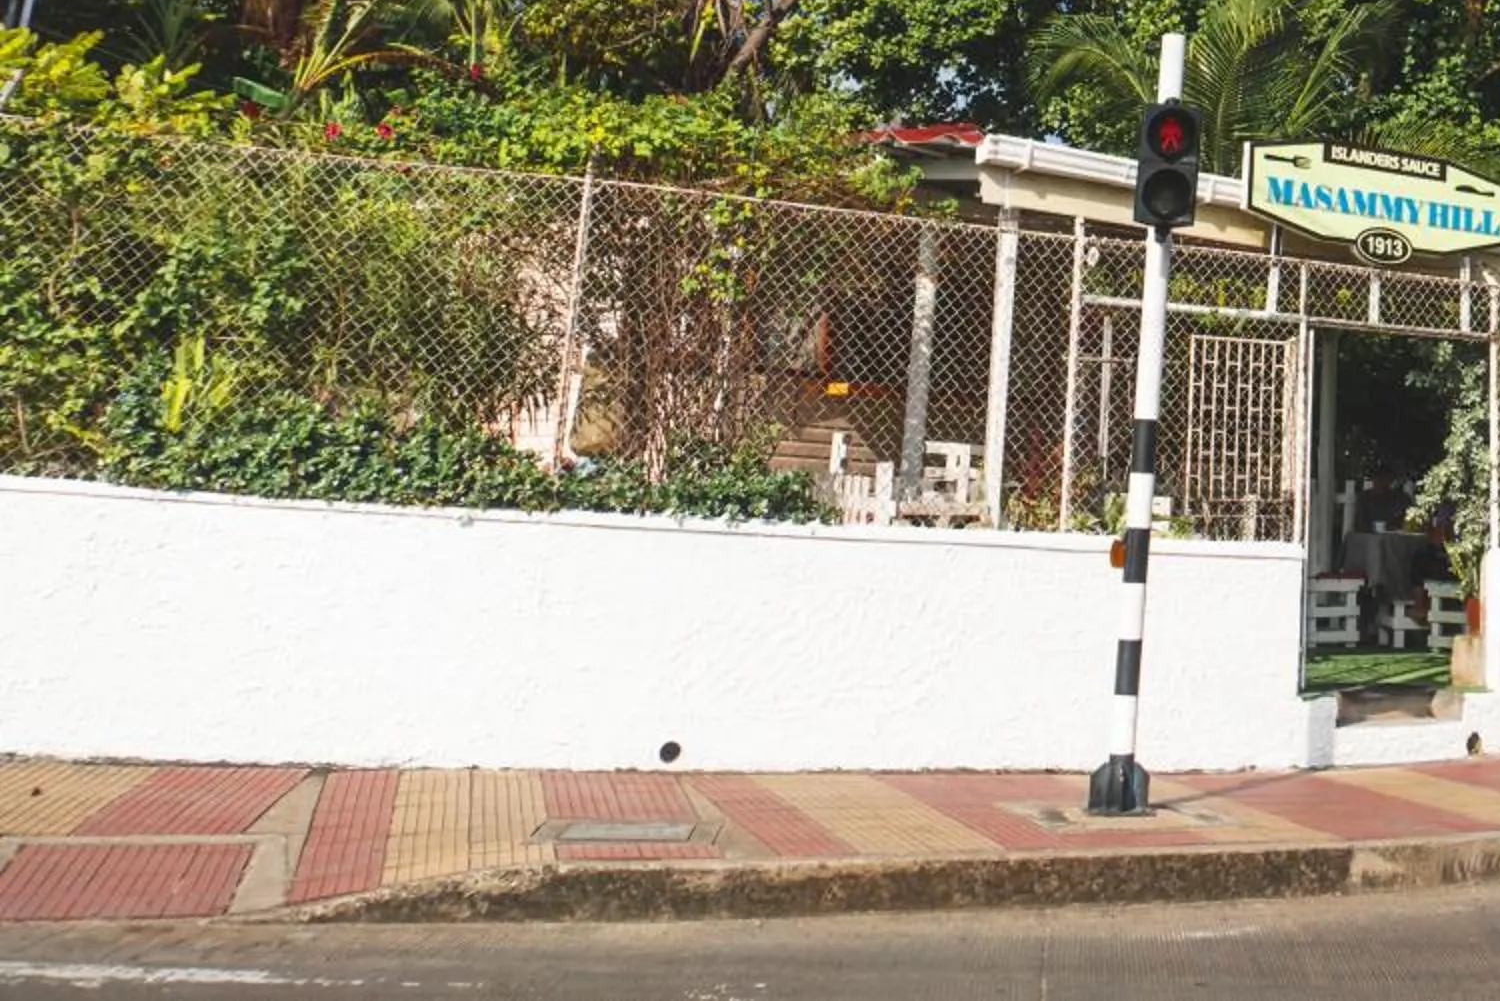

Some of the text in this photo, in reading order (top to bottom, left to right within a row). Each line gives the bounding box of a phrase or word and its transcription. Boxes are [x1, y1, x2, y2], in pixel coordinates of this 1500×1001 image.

[1331, 145, 1441, 177] ISLANDERS SAUCE
[1267, 176, 1500, 236] MASAMMY HILL
[1366, 236, 1403, 256] 1913
